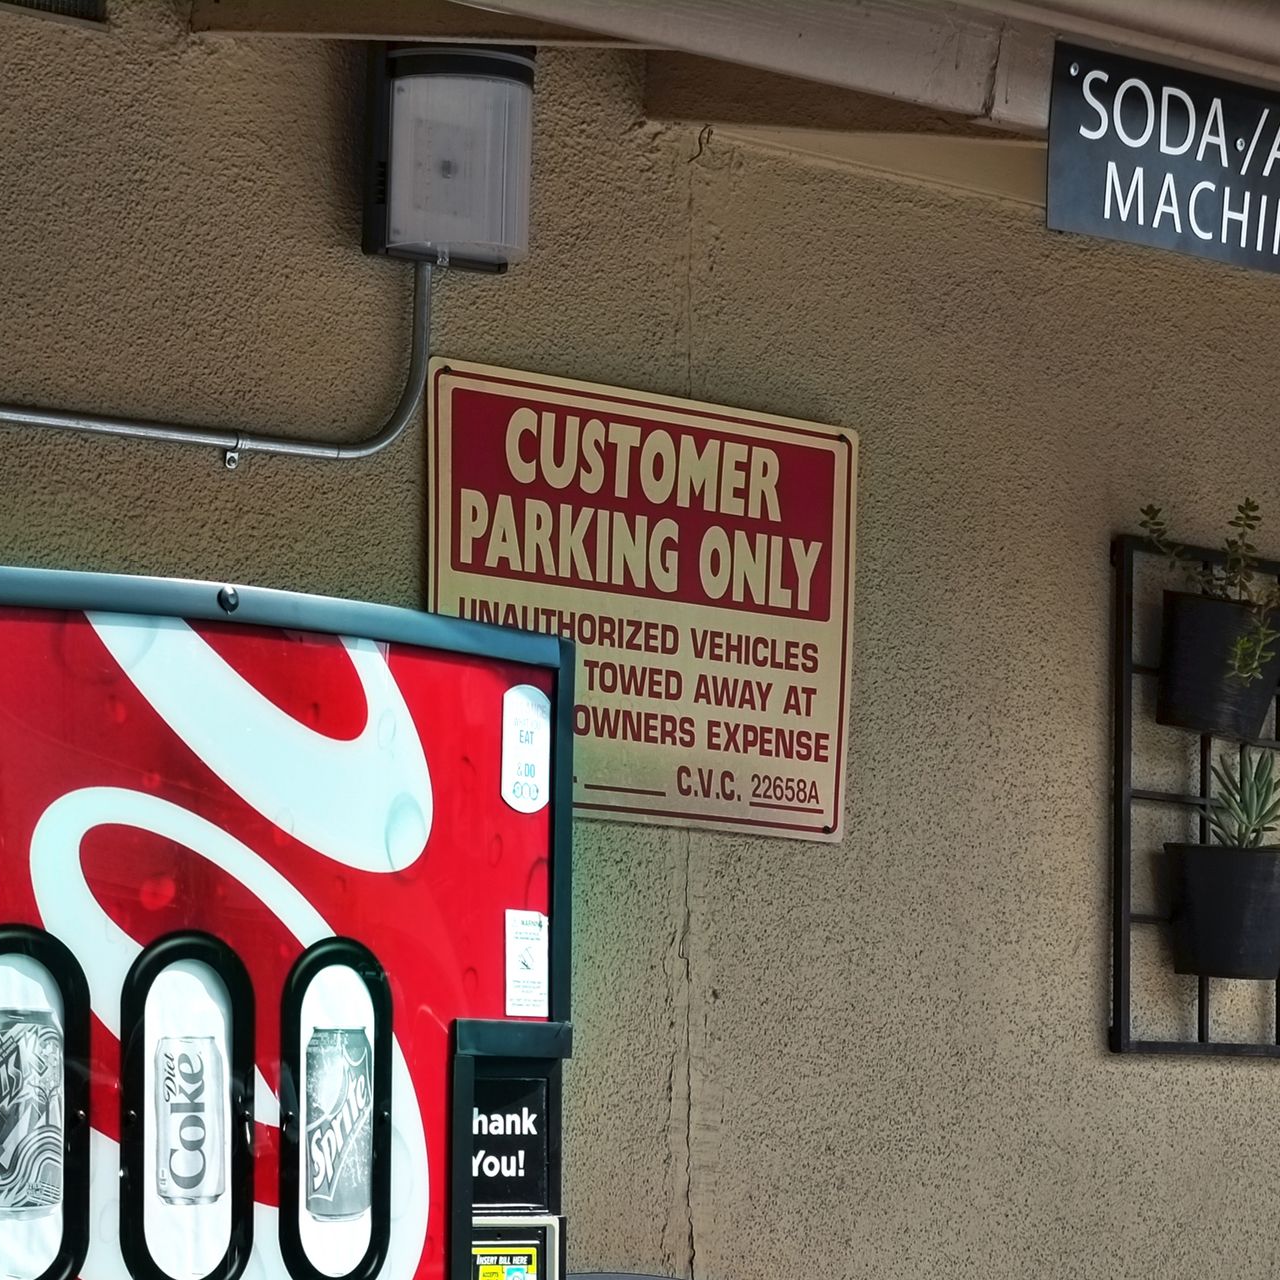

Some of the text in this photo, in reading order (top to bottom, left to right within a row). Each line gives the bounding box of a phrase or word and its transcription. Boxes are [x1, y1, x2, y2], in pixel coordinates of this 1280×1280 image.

[505, 407, 782, 522] CUSTOMER
[459, 488, 823, 612] PARKING ONLY
[690, 627, 819, 674] VEHICLES
[584, 659, 818, 717] TOWED AWAY AT
[519, 729, 535, 745] EAT
[573, 704, 696, 749] OWNERS
[706, 723, 830, 764] EXPENSE
[676, 765, 820, 806] C.V.C. 22658A
[164, 1053, 177, 1103] Diet
[168, 1052, 206, 1190] Coke
[311, 1074, 368, 1191] Sprite
[472, 1106, 538, 1135] hank
[472, 1149, 525, 1178] You!
[476, 1254, 529, 1265] INSERT BILL HERE
